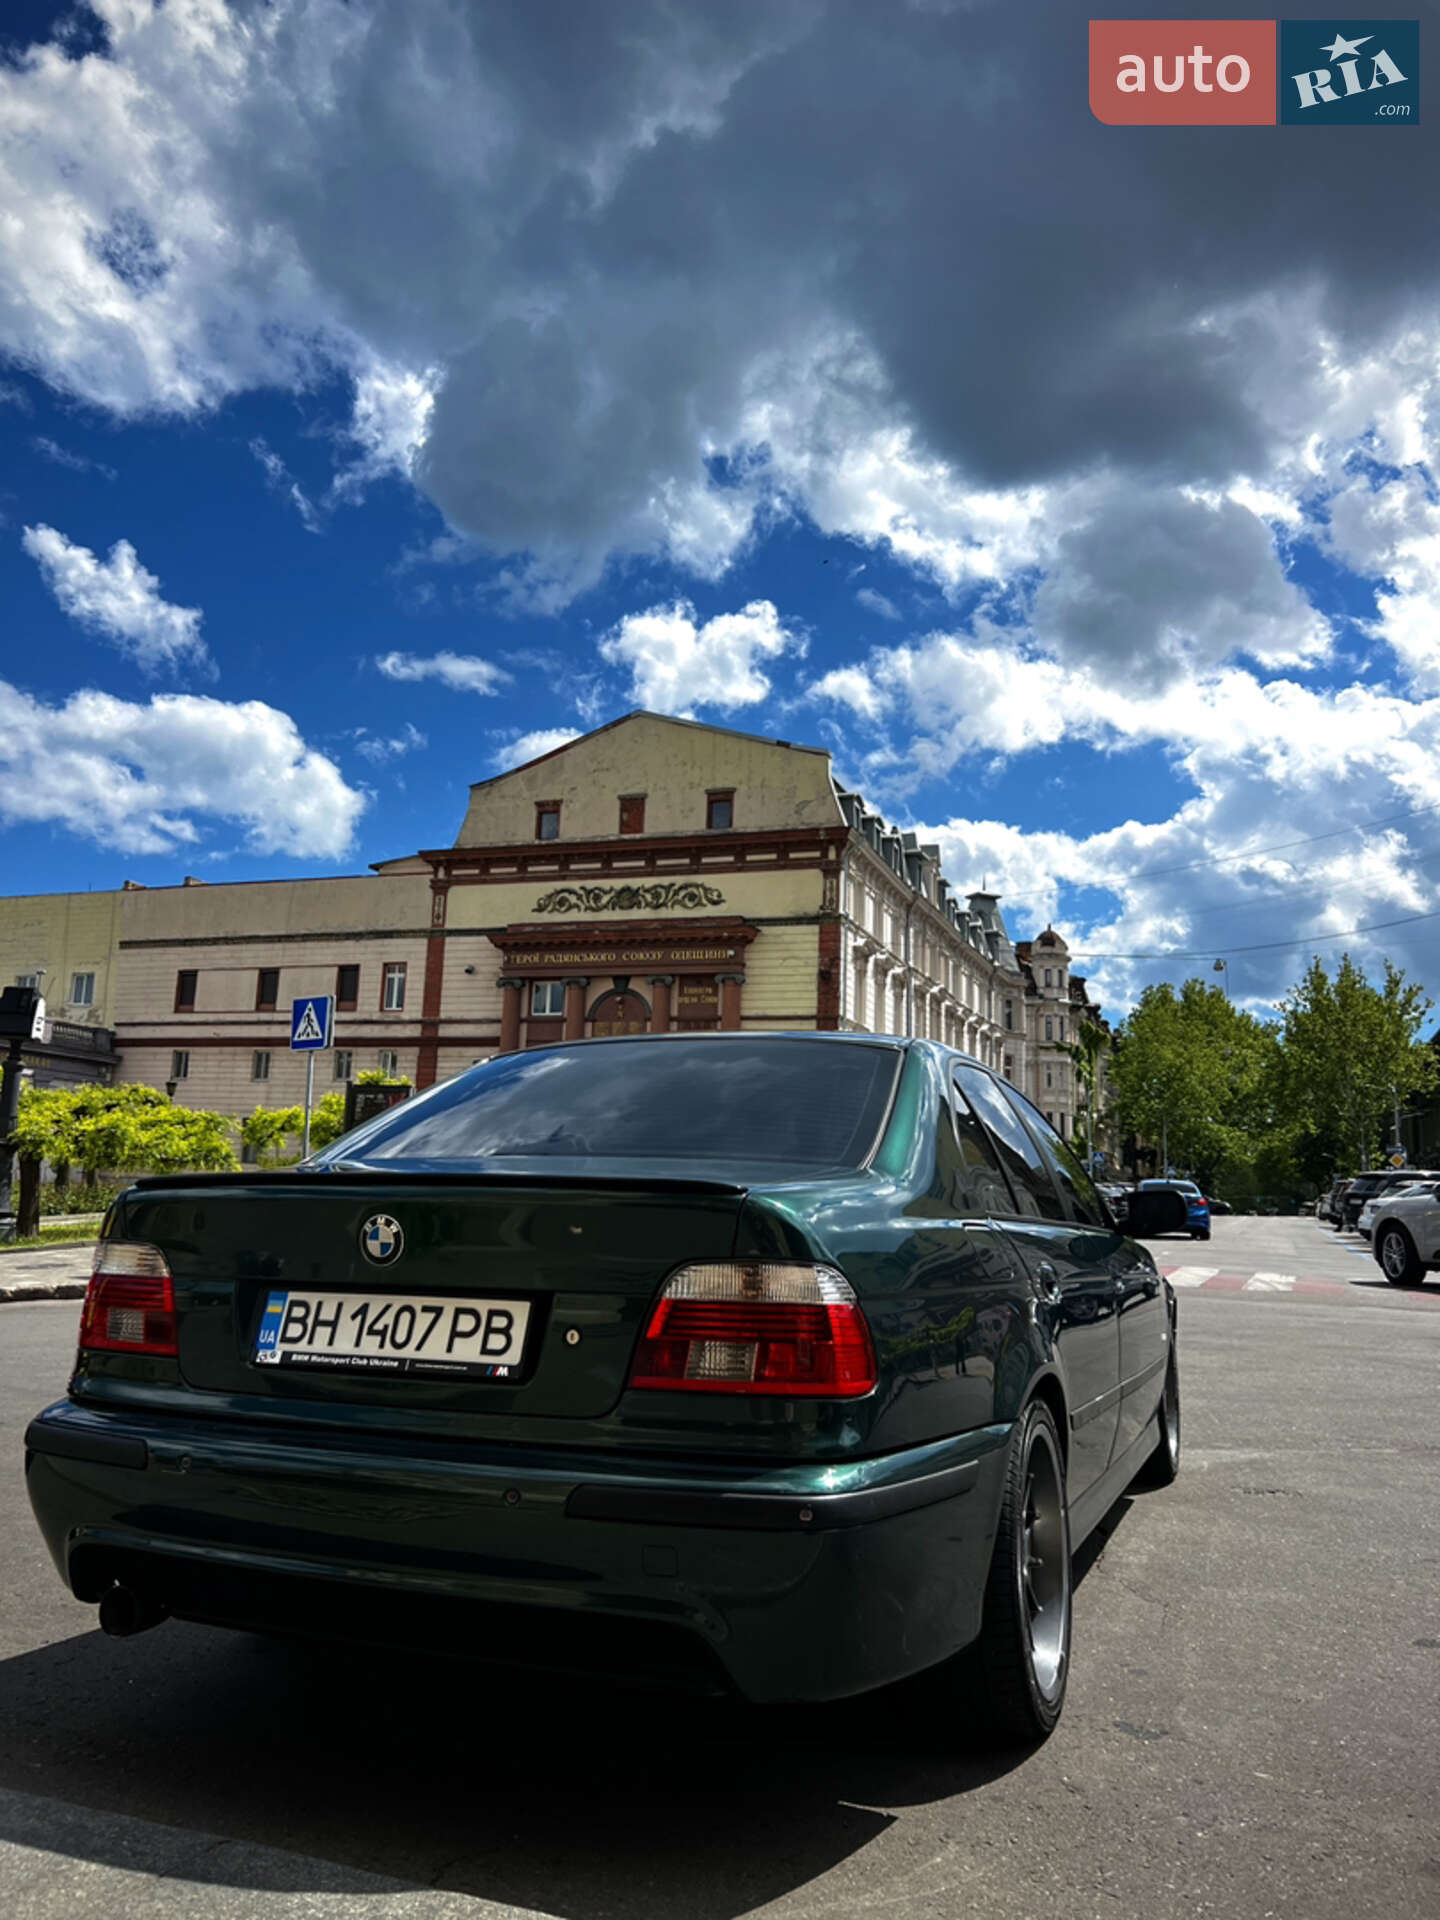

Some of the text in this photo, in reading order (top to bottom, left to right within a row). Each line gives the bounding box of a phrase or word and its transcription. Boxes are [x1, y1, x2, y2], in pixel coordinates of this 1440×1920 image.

[364, 1216, 399, 1233] BMW
[279, 1299, 515, 1357] BH 1407 PB
[259, 1329, 275, 1344] UA
[370, 1358, 399, 1368] Ukraine
